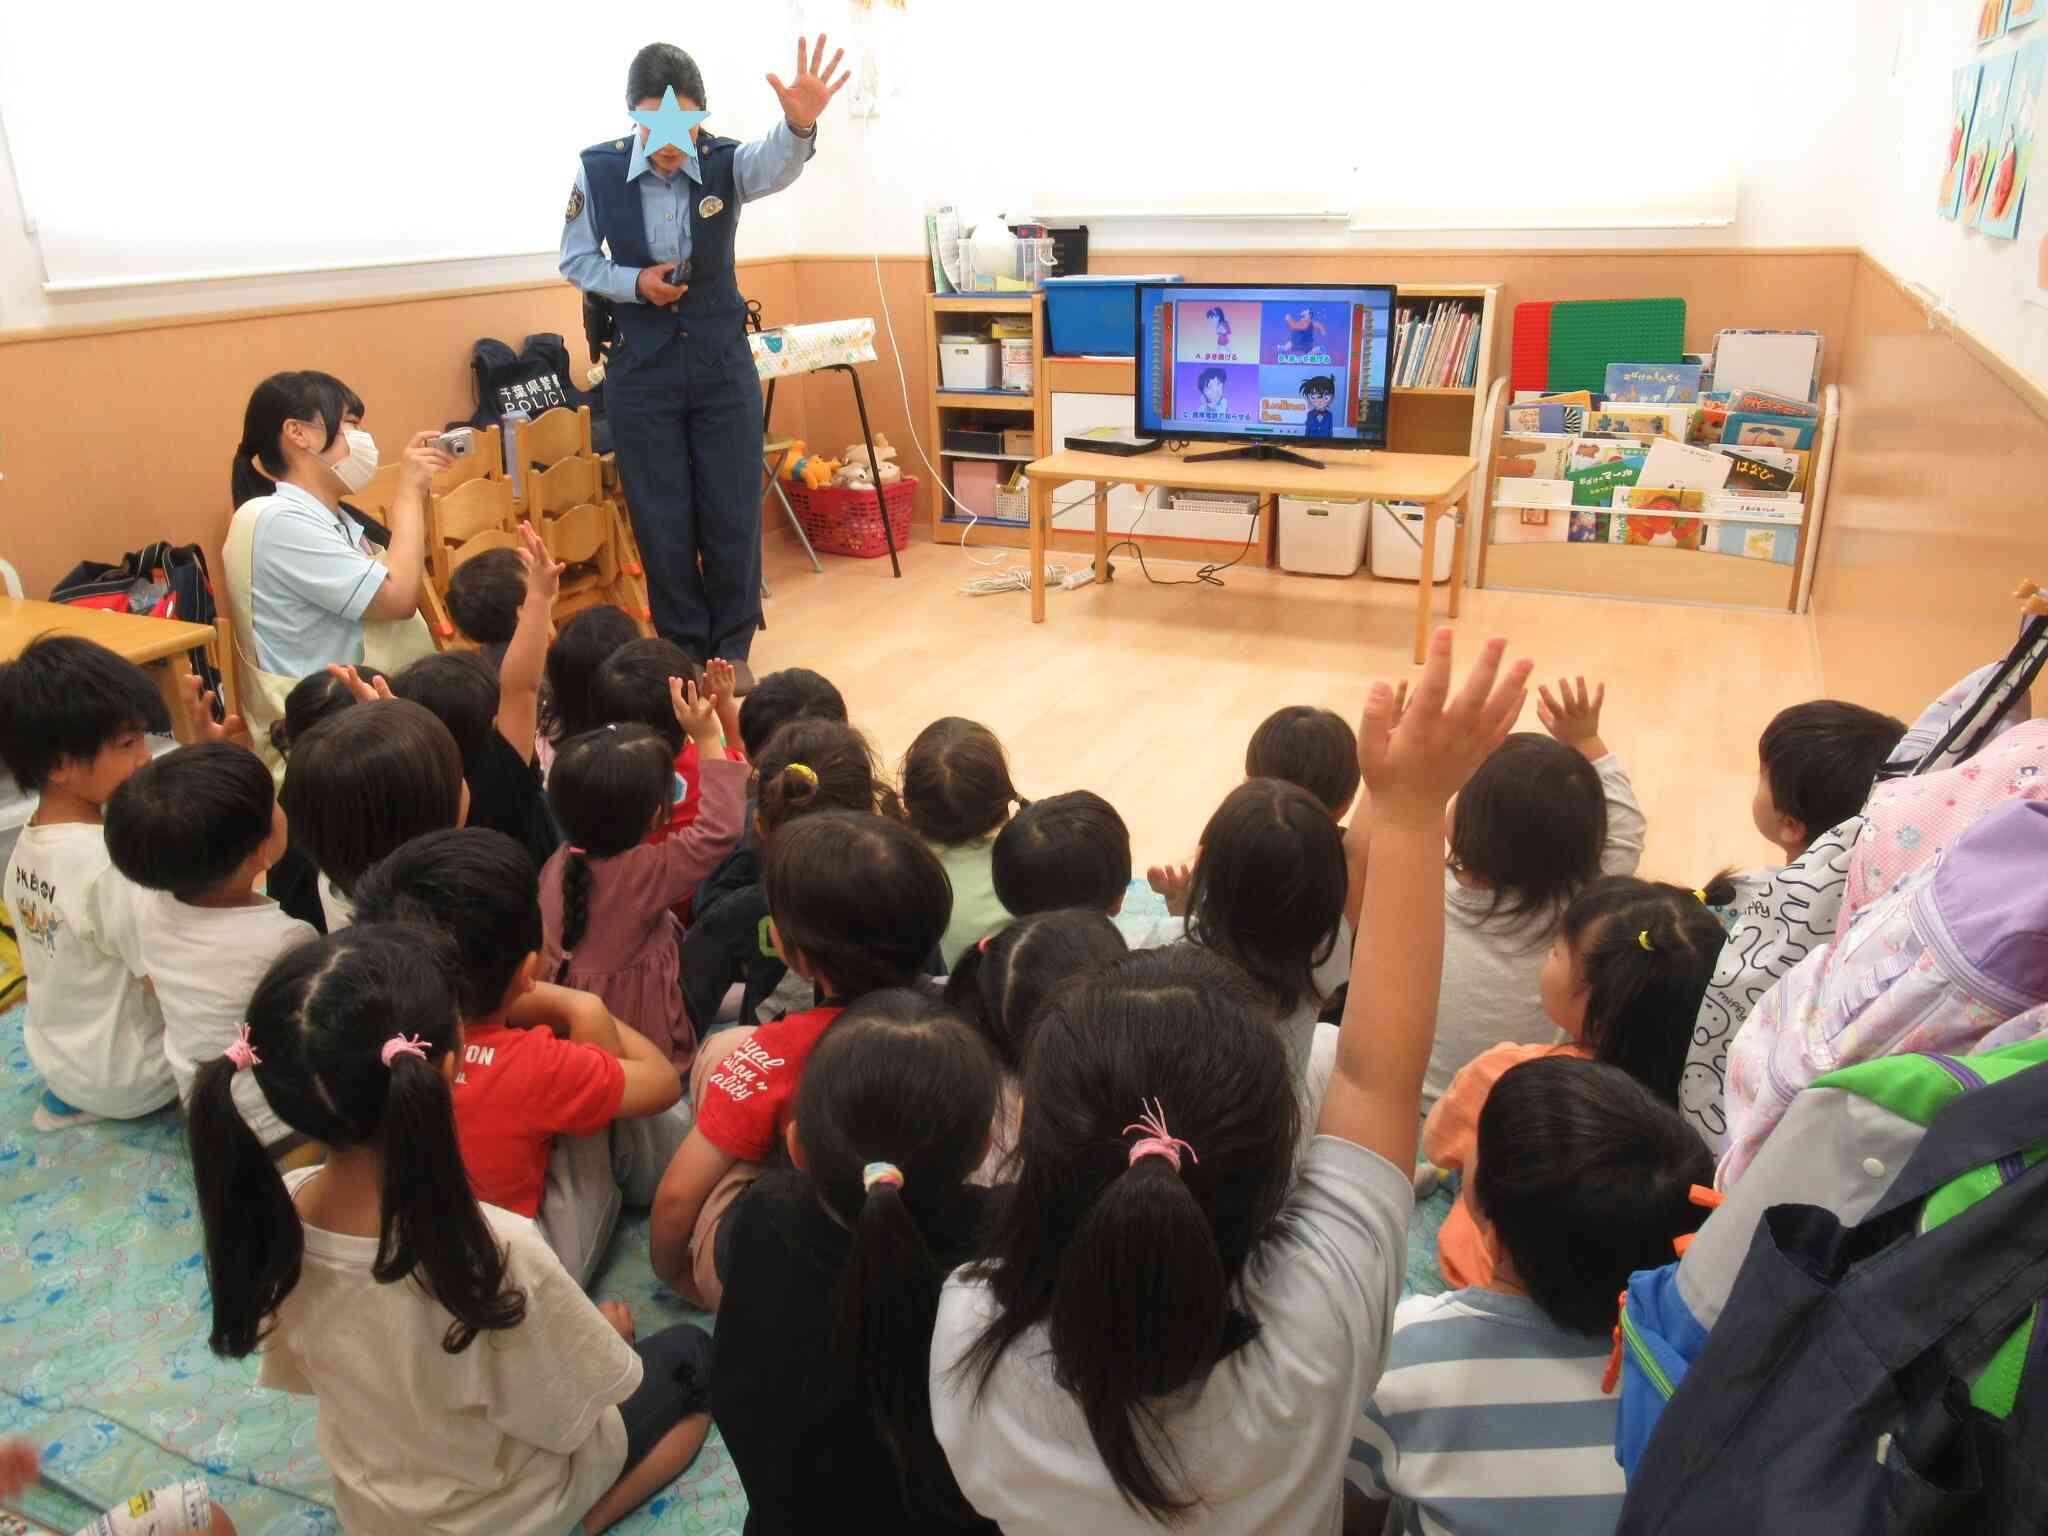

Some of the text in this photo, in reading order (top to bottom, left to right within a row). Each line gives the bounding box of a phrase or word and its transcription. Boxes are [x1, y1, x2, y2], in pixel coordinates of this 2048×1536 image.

[1736, 460, 1775, 480] はなび
[464, 1043, 496, 1067] ON
